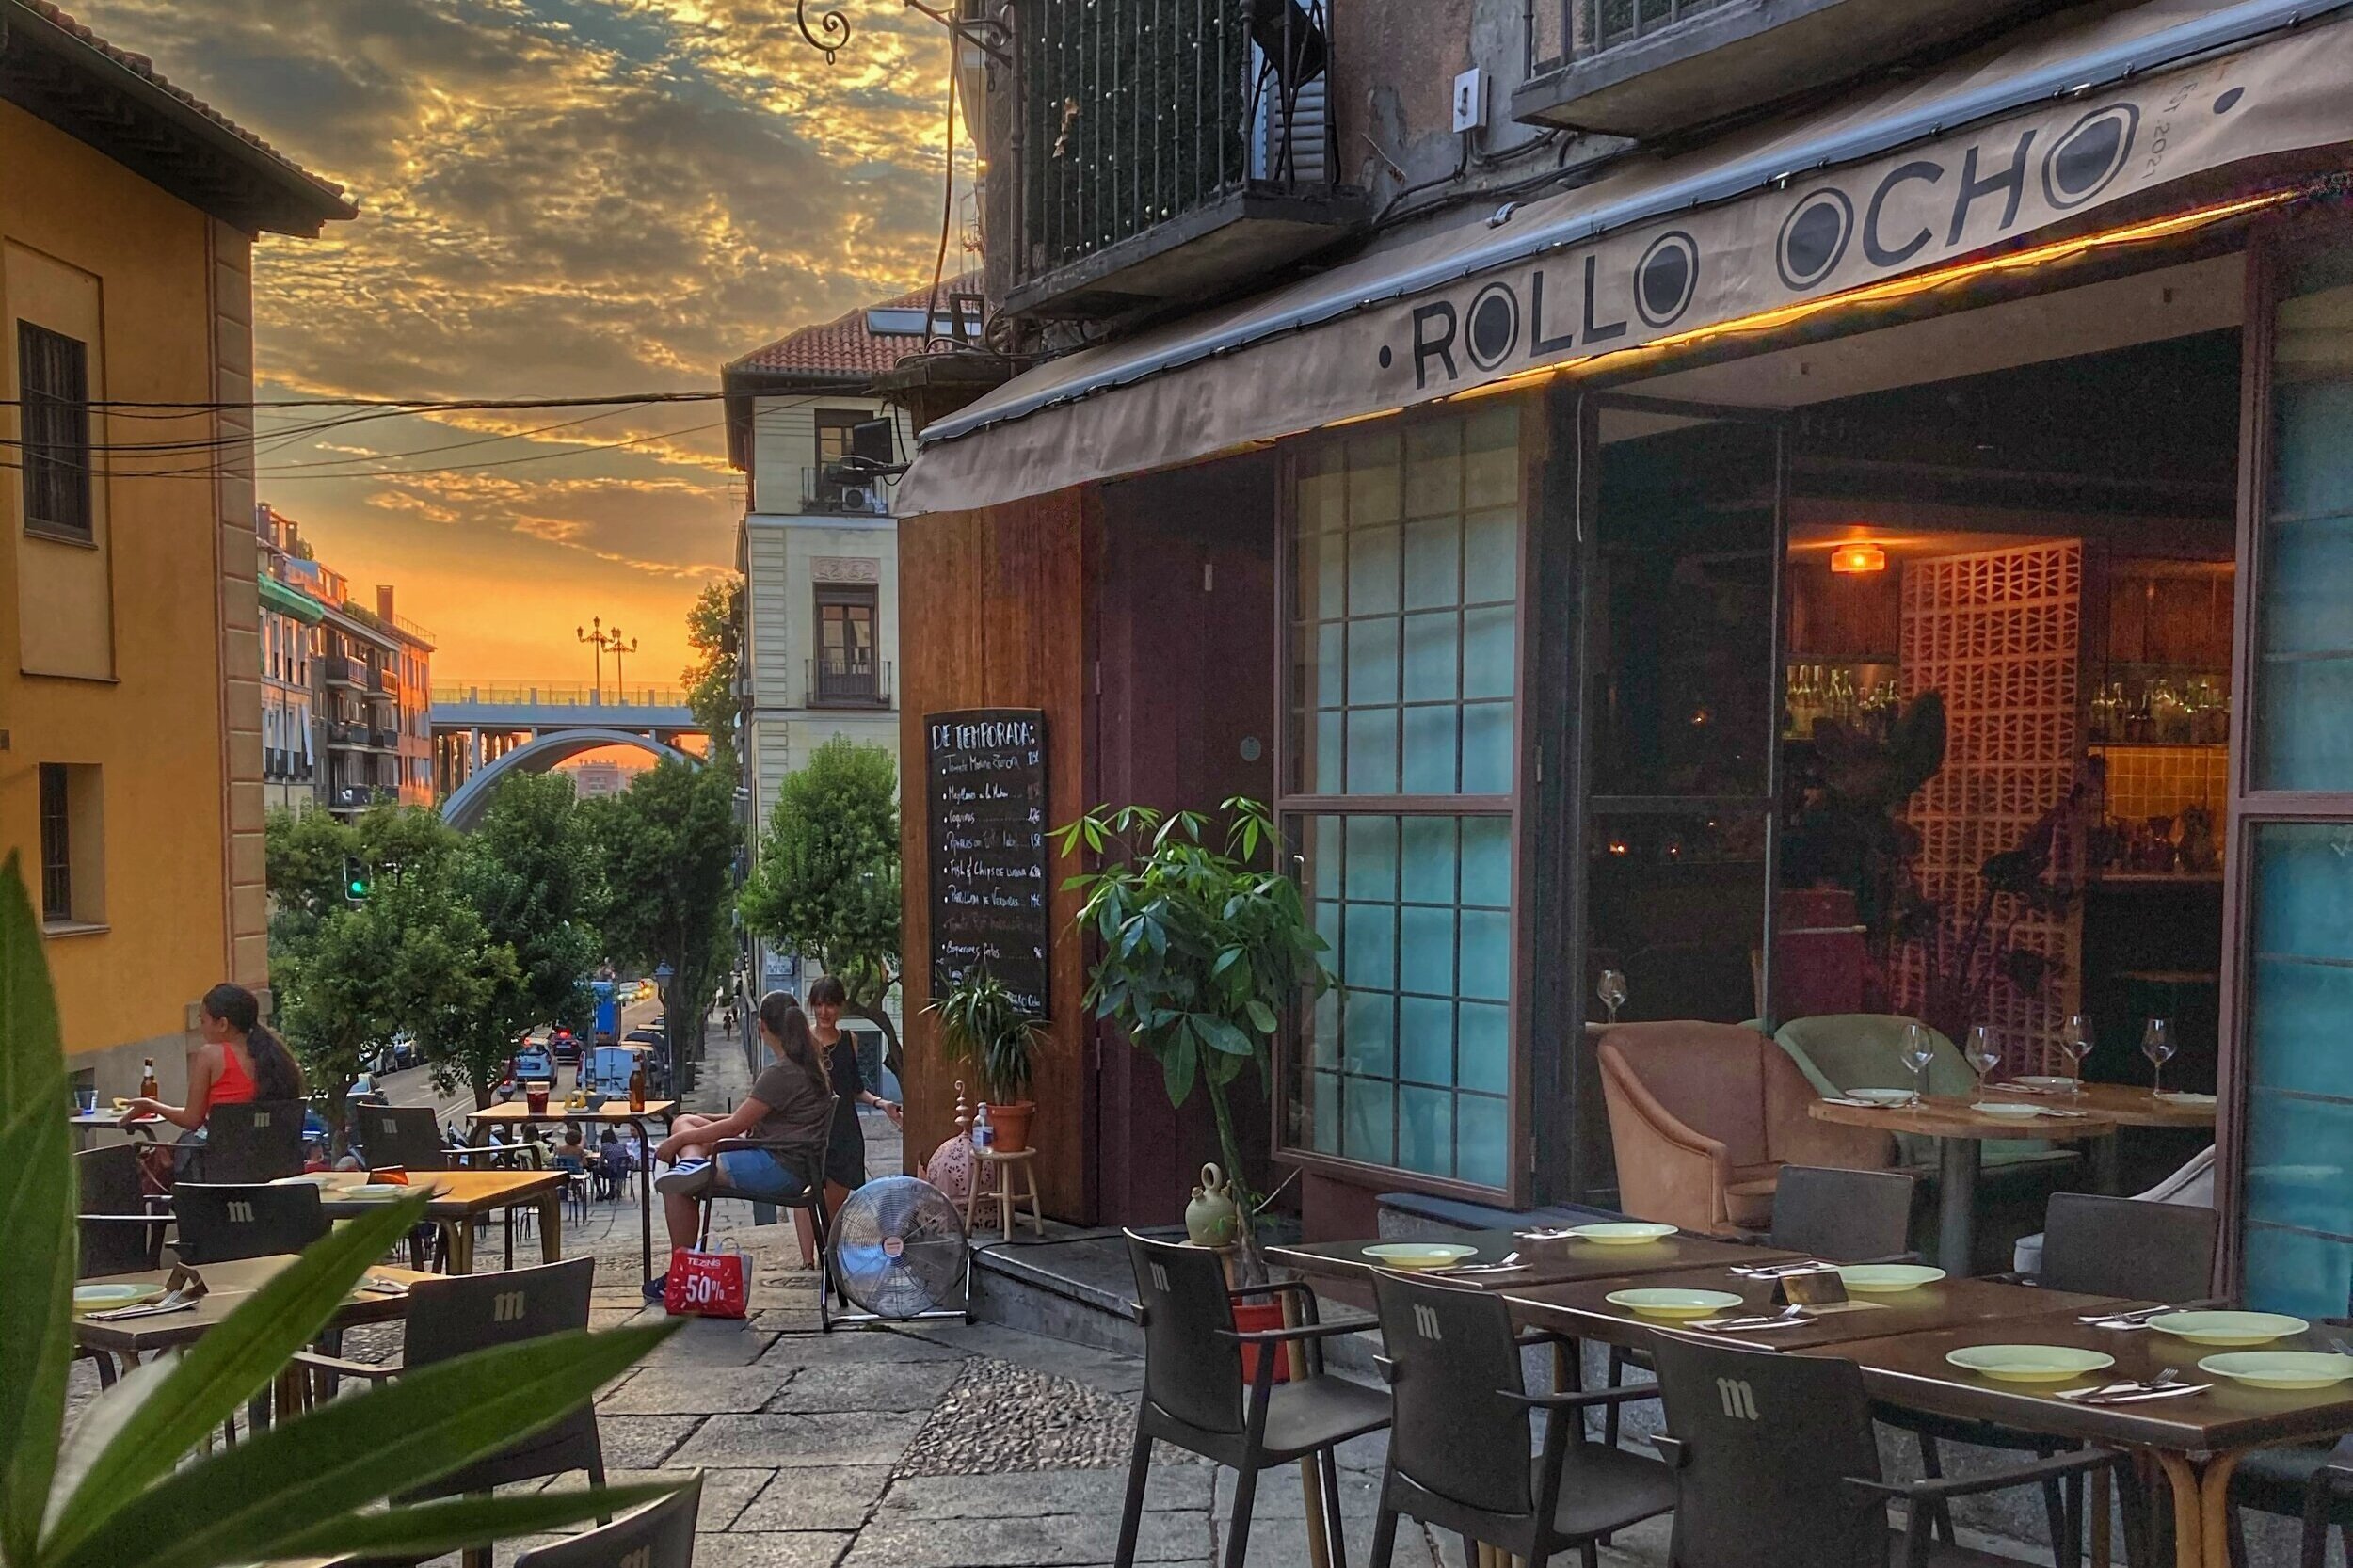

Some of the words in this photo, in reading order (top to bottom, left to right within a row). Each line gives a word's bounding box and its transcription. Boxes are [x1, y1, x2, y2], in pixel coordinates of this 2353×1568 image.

[1412, 231, 1700, 391] ROLLO
[1775, 103, 2141, 299] OCHO
[932, 723, 952, 751] DE
[685, 1274, 725, 1304] 50%
